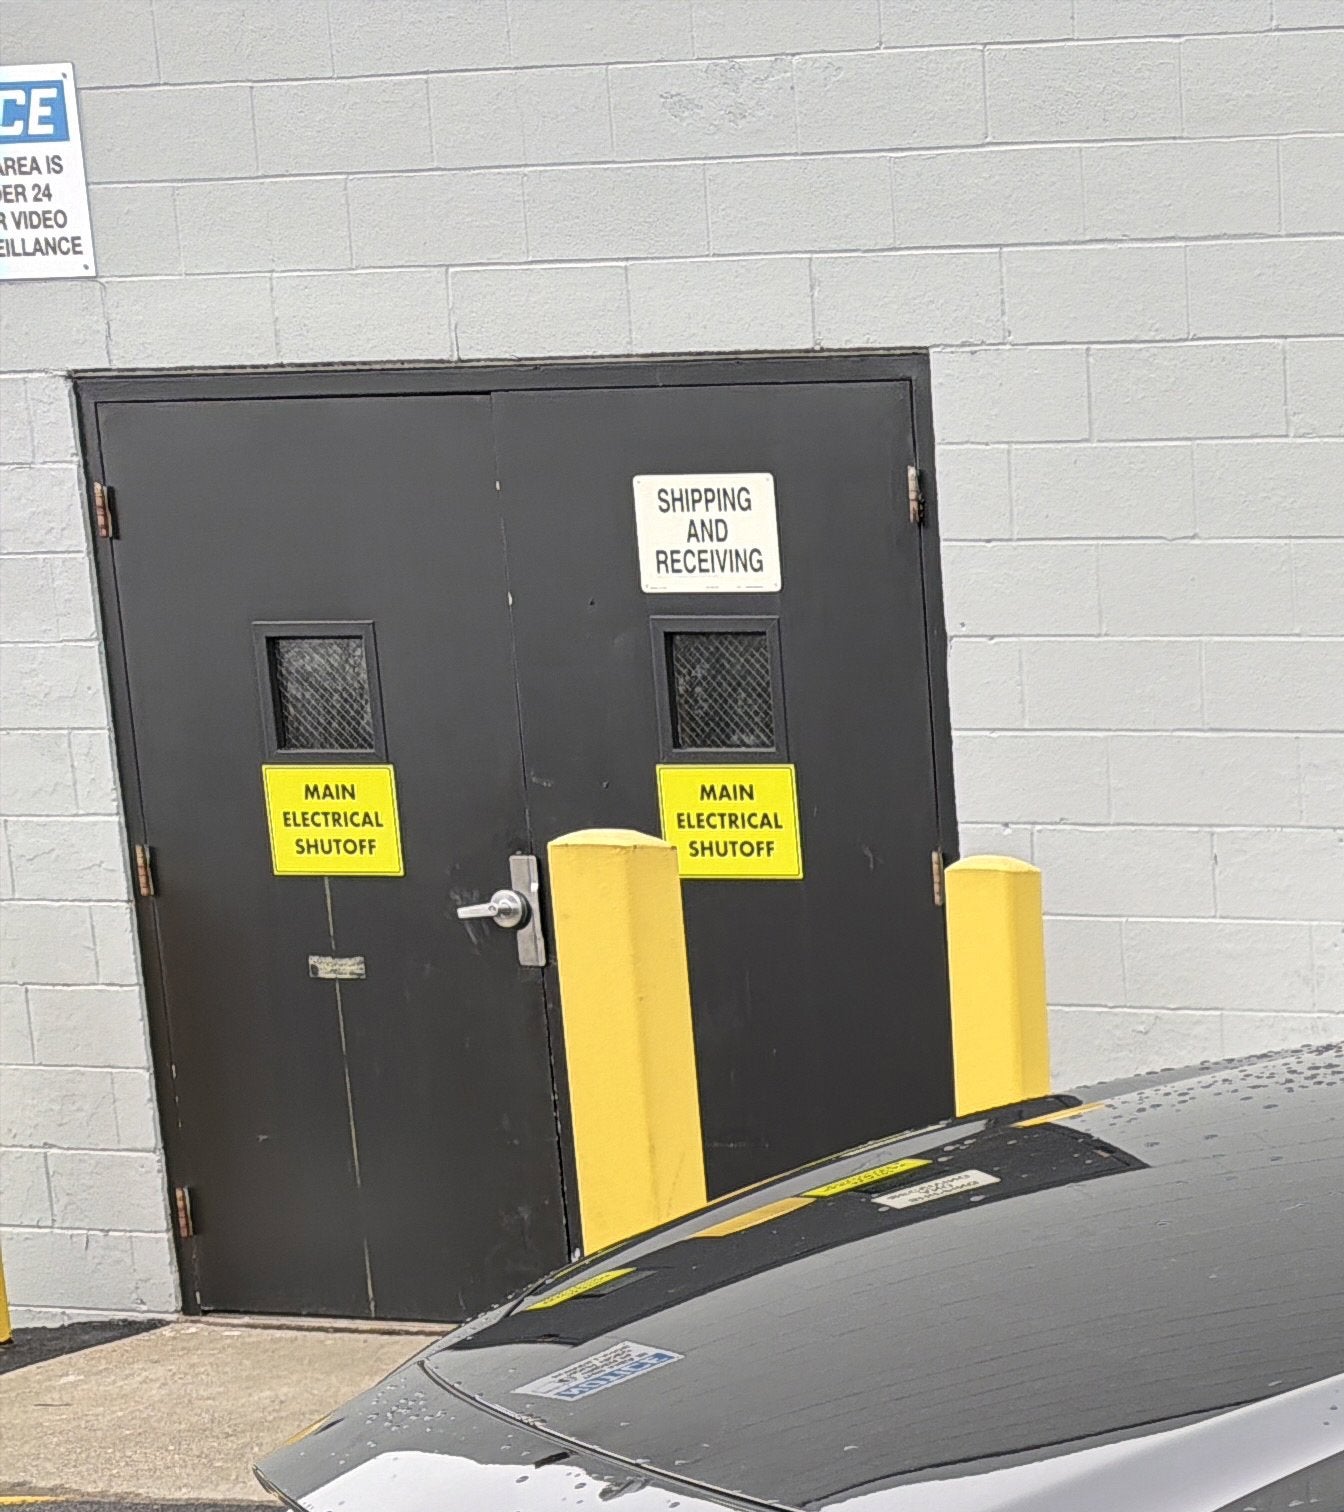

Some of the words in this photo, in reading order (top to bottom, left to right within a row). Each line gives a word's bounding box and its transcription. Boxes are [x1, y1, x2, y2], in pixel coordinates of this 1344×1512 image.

[0, 88, 57, 135] CE
[46, 154, 63, 175] IS
[0, 184, 27, 203] ER
[32, 183, 52, 202] 24
[10, 209, 67, 230] VIDEO
[657, 486, 752, 513] SHIPPING
[687, 518, 728, 543] AND
[656, 548, 763, 574] RECEIVING
[304, 783, 356, 800] MAIN
[700, 784, 754, 801] MAIN
[282, 811, 384, 828] ELECTRICAL
[676, 812, 783, 829] ELECTRICAL
[295, 838, 376, 855] SHUTOFF
[689, 840, 775, 858] SHUTOFF
